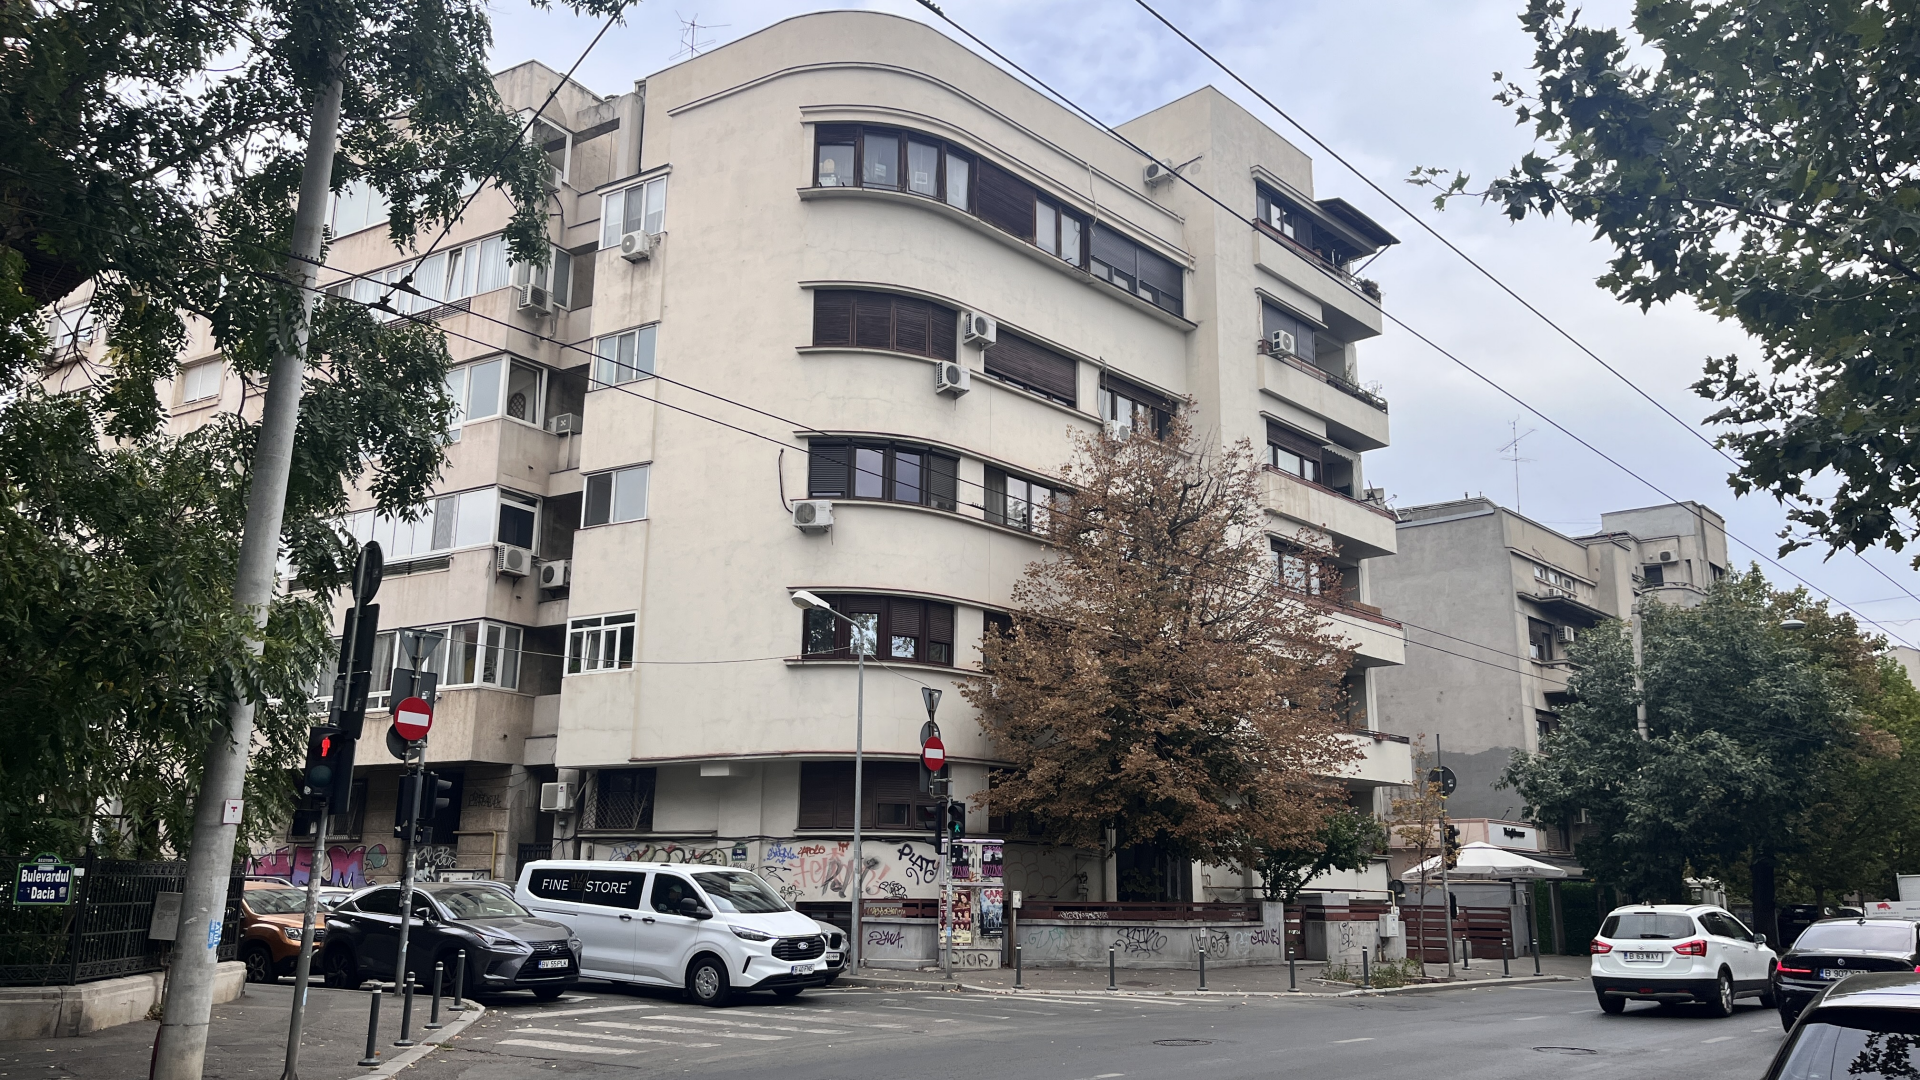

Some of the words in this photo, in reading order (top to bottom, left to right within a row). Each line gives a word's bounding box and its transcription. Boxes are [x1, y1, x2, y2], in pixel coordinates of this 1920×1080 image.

[21, 870, 69, 882] Bulevardul
[541, 879, 570, 891] FINE
[31, 886, 55, 899] Dacia
[1825, 969, 1831, 977] B
